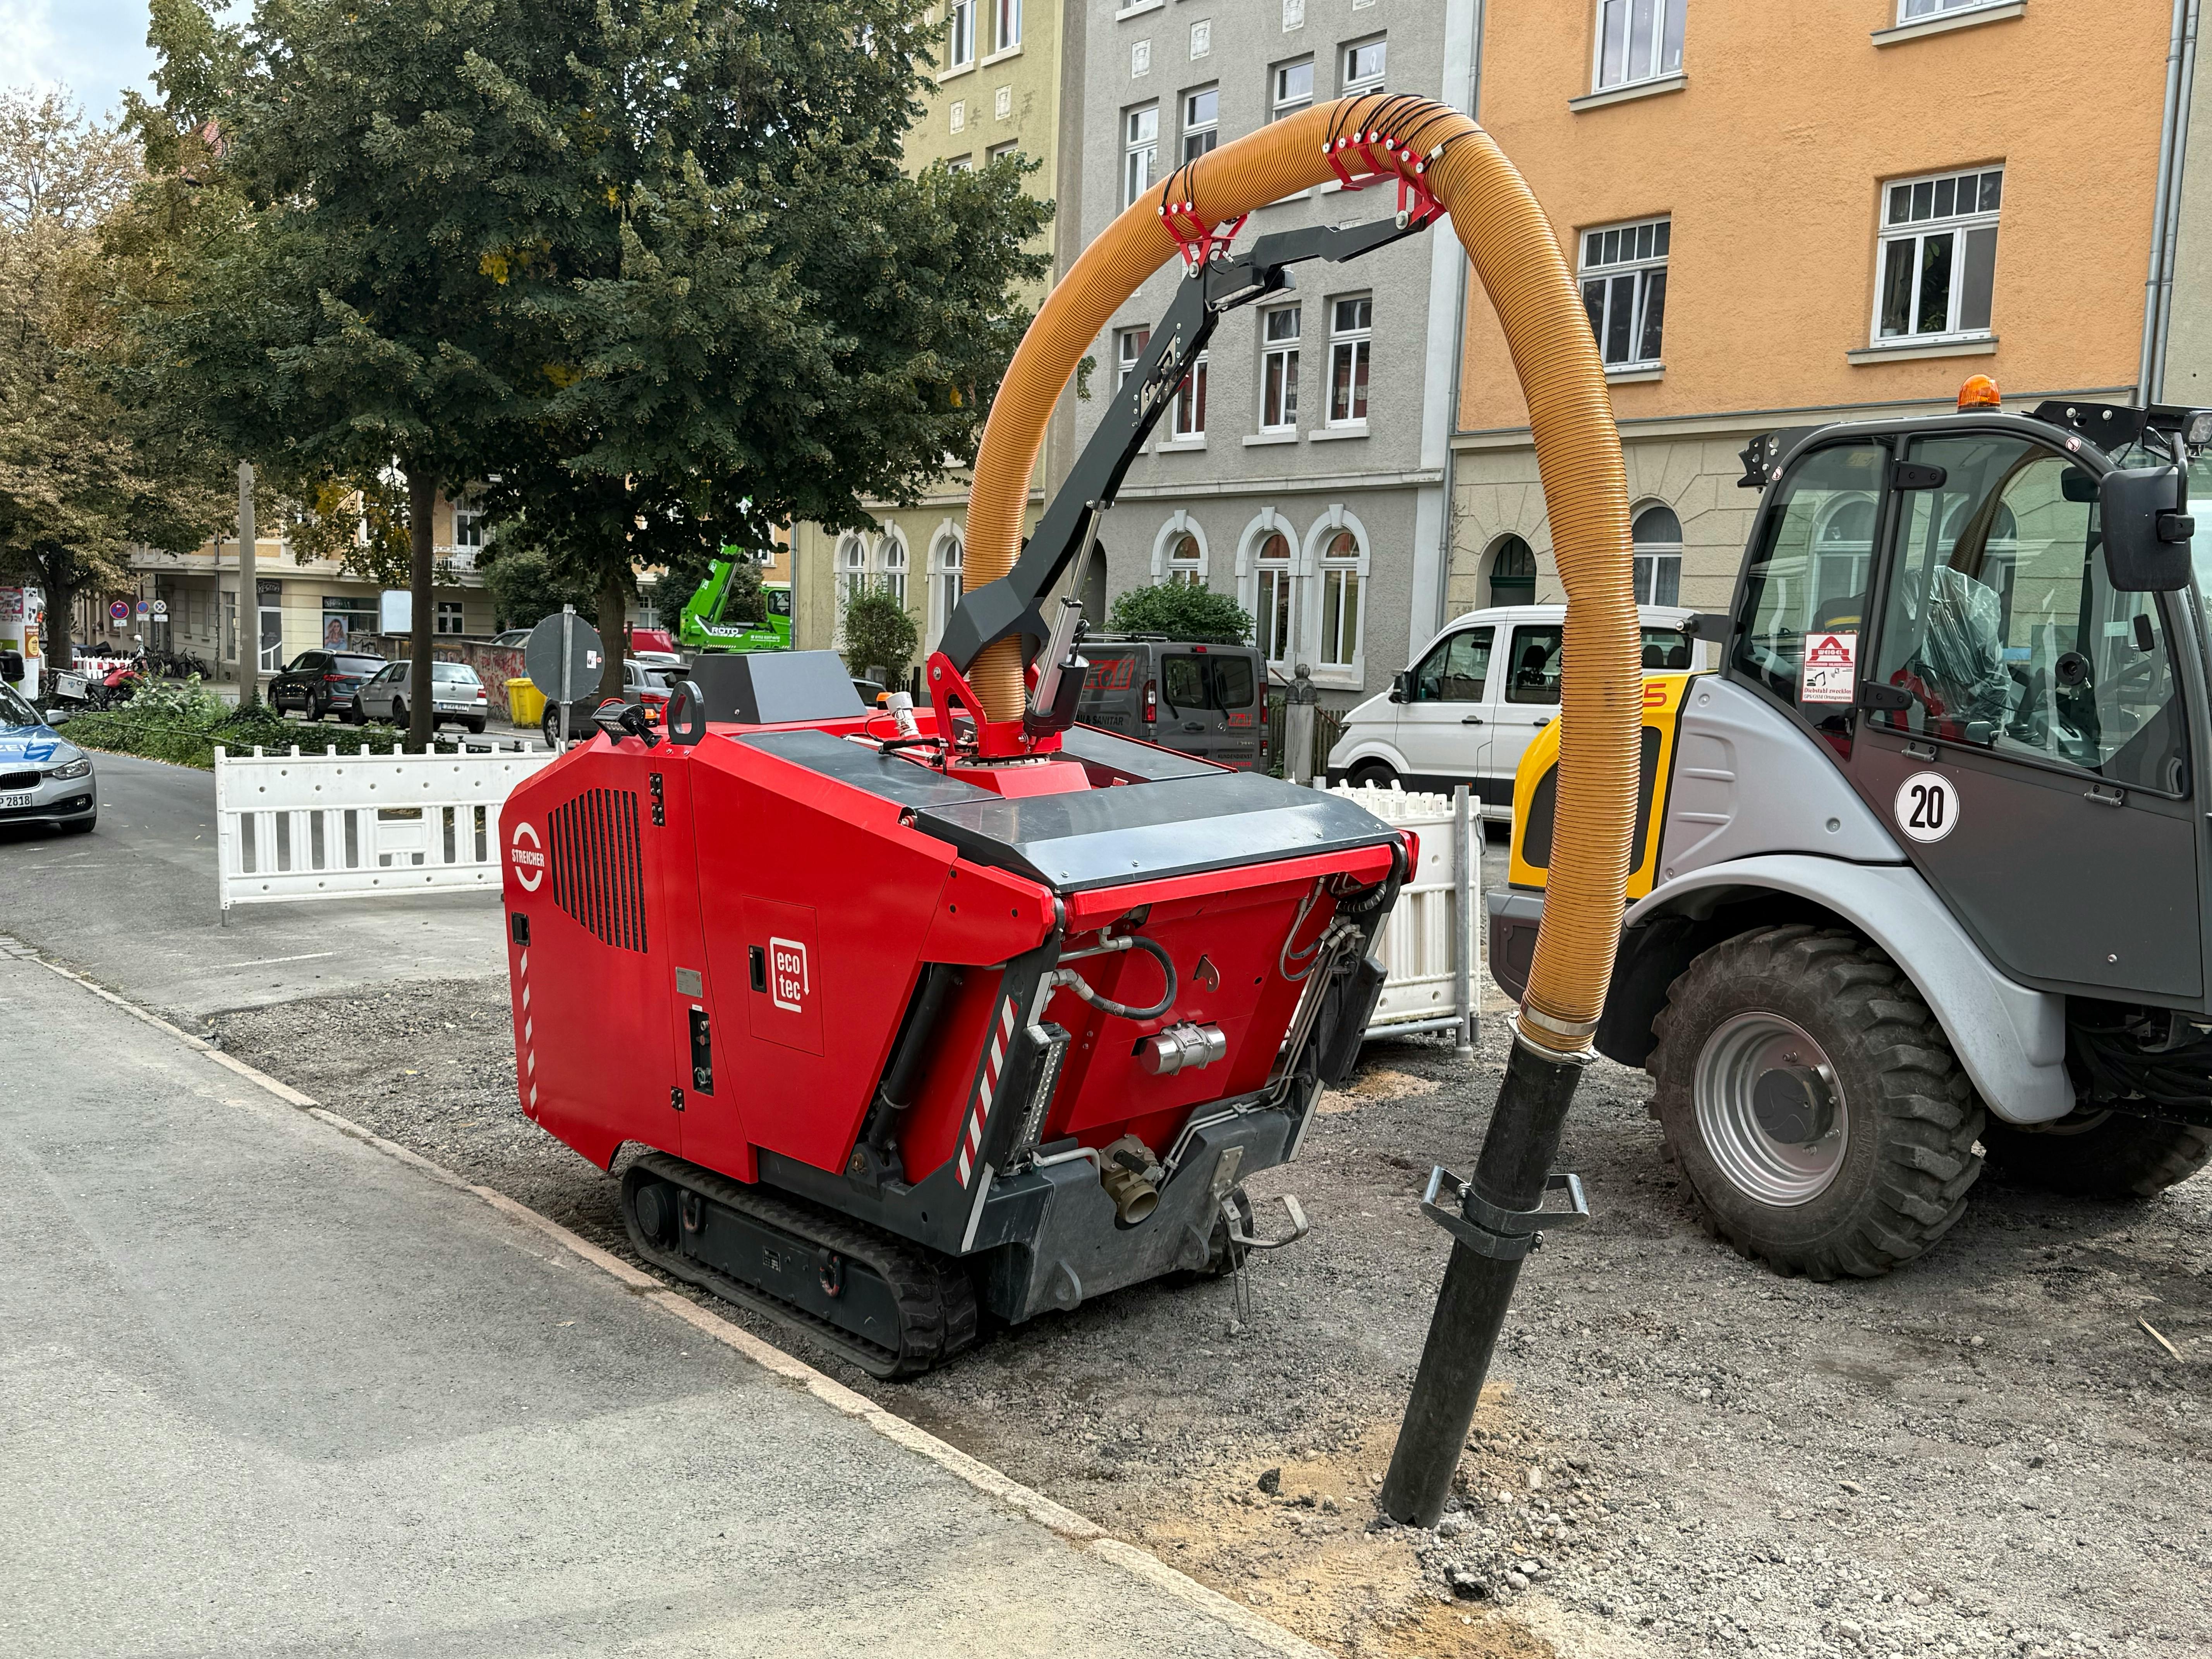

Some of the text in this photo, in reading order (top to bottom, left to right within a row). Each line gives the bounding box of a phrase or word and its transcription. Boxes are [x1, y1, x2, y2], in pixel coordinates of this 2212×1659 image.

[1093, 714, 1123, 725] SANITÄR
[7, 796, 30, 806] 2818
[1909, 785, 1944, 828] 20
[512, 848, 544, 867] STREICHER
[777, 952, 800, 974] eco
[779, 974, 800, 1000] tec
